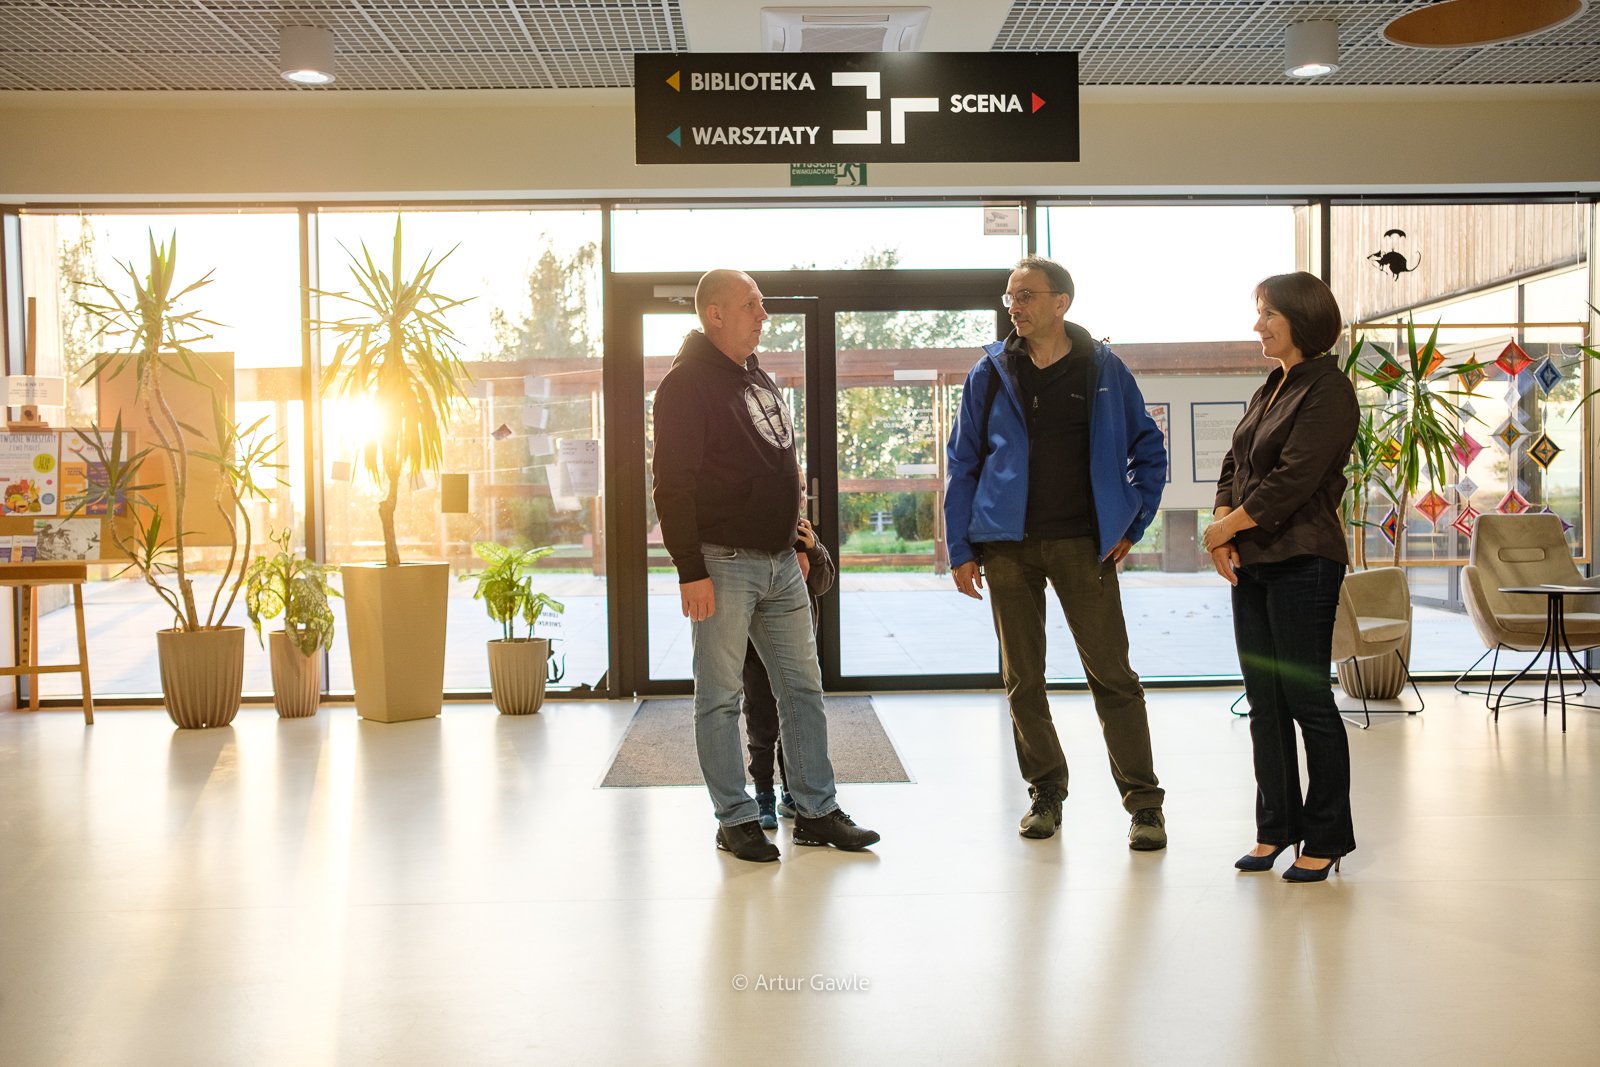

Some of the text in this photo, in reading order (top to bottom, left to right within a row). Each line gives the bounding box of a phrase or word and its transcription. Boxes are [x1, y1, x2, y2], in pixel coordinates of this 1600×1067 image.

[691, 72, 816, 91] BIBLIOTEKA
[950, 93, 1024, 114] SCENA
[692, 126, 821, 145] WARSZTATY
